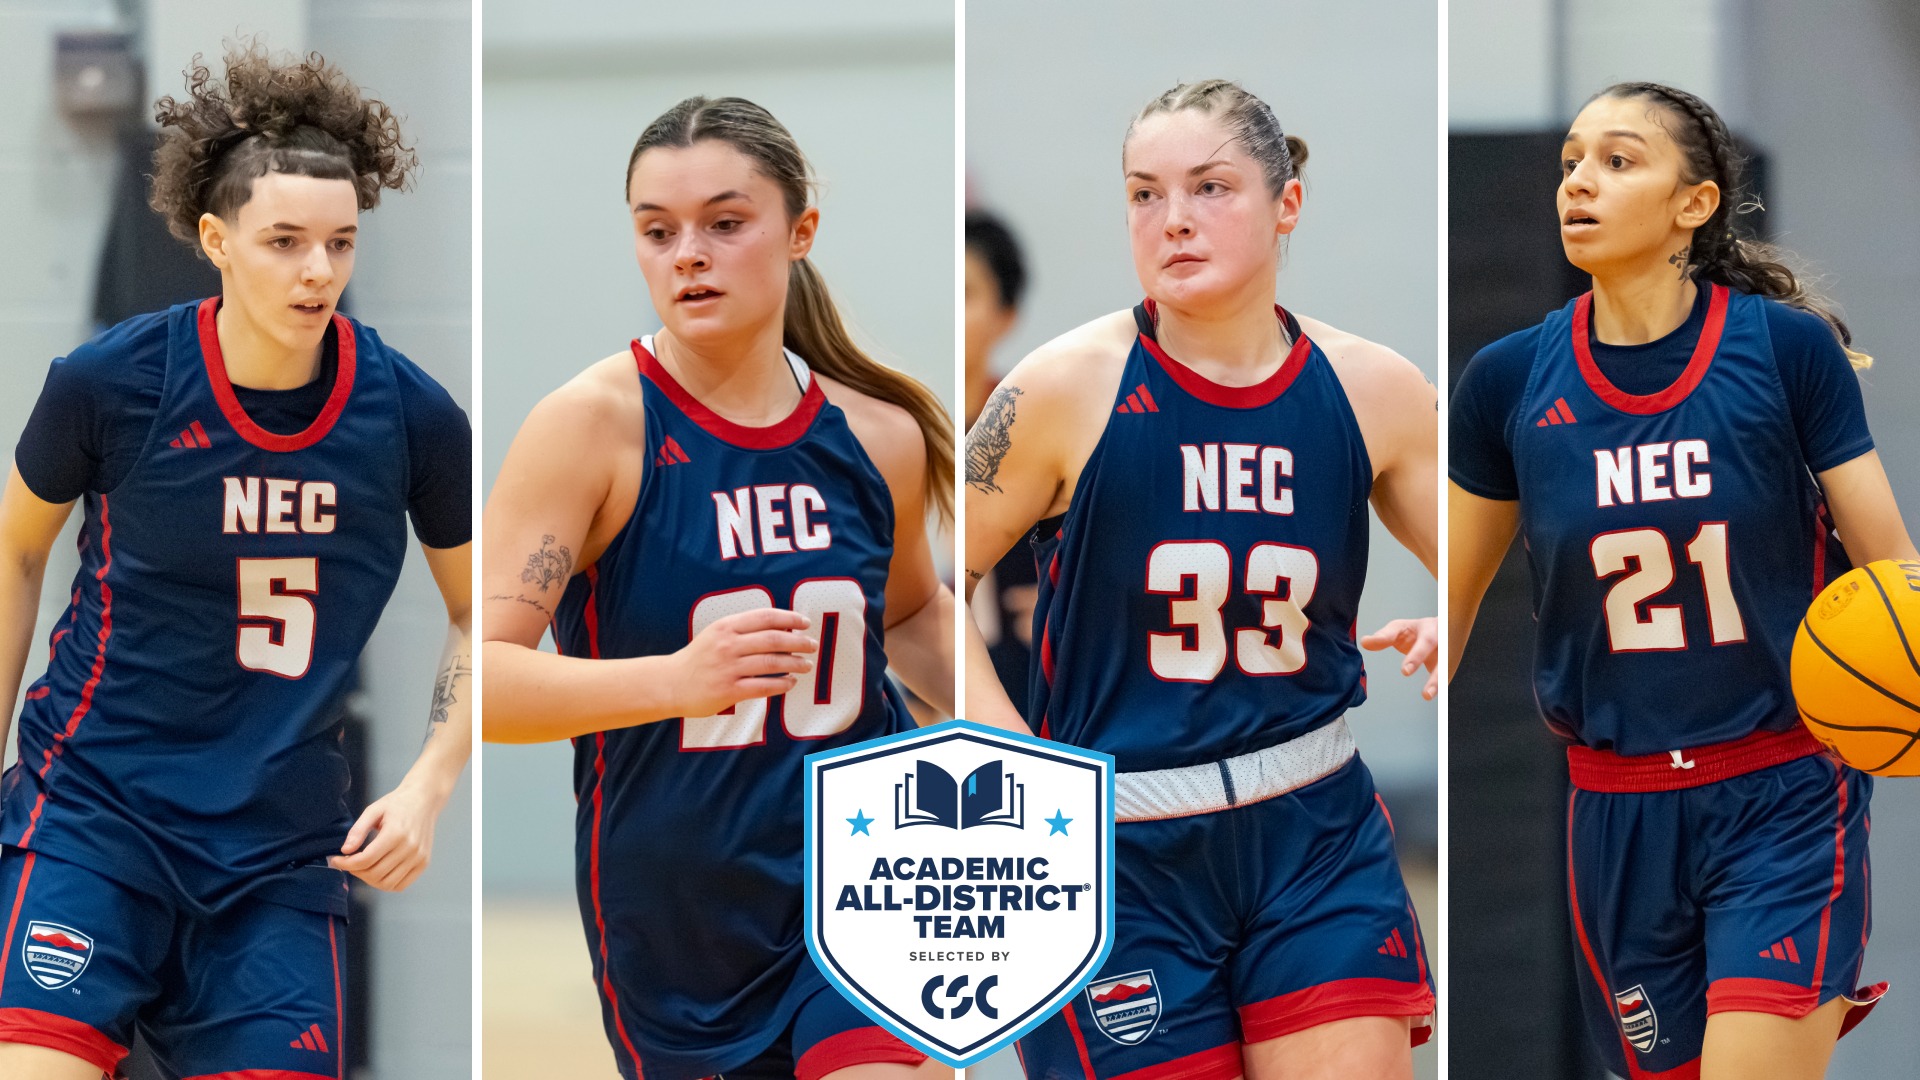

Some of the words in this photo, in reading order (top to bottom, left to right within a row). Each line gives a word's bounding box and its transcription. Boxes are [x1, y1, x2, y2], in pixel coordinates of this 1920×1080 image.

[222, 476, 338, 535] NEC
[1180, 442, 1295, 517] NEC
[1593, 438, 1712, 508] NEC
[710, 483, 832, 561] NEC
[236, 556, 319, 680] 5
[1144, 539, 1319, 684] 33
[1588, 520, 1748, 654] 21
